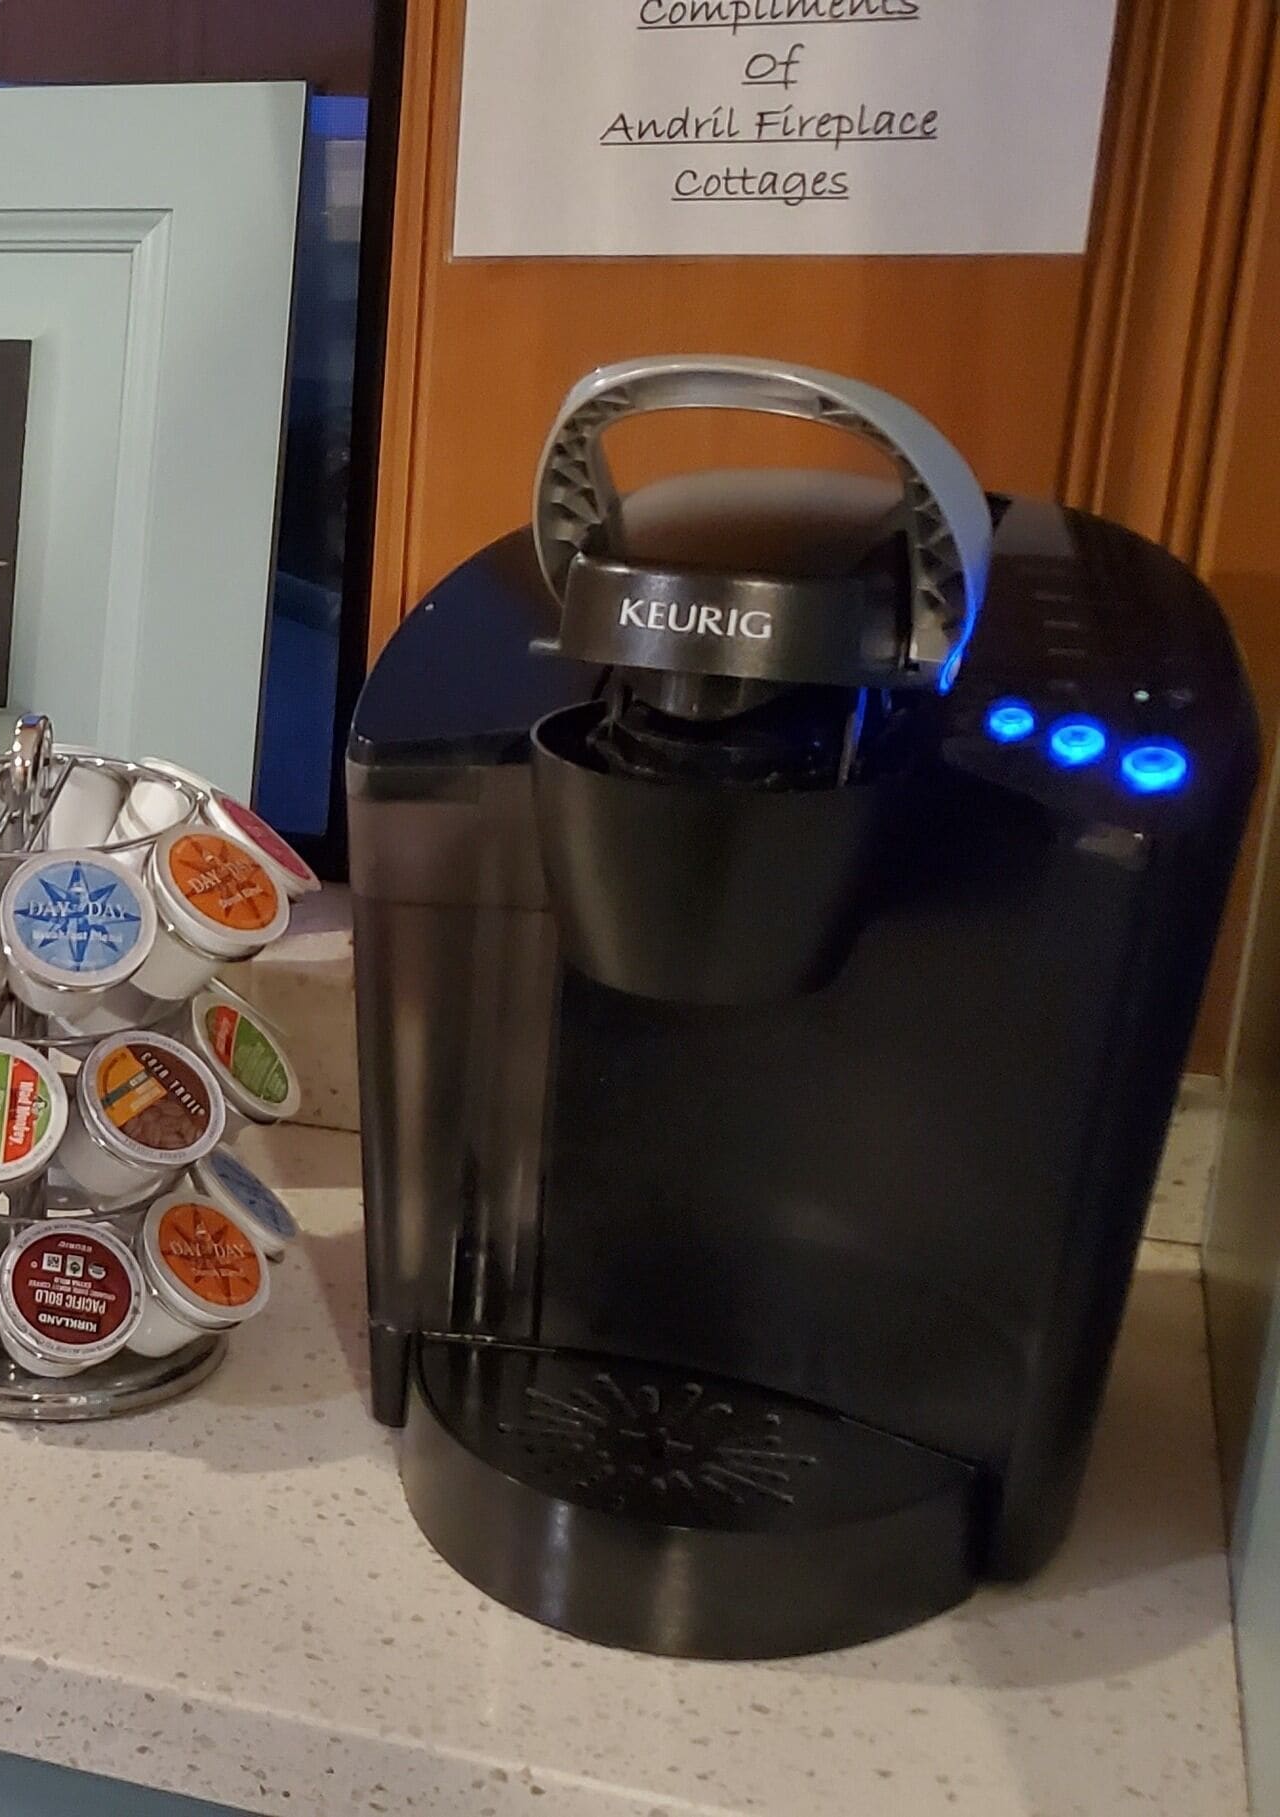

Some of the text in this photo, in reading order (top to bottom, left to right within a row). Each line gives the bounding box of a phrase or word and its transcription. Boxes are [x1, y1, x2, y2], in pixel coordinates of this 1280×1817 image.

[638, 0, 919, 35] Compliments
[744, 44, 805, 89] Of
[600, 103, 939, 150] Andril Fireplace
[673, 167, 850, 206] Cottages
[617, 596, 774, 640] KEURIG
[28, 900, 127, 919] DAY DAY
[35, 1288, 107, 1315] PACIFIC BOLD
[38, 1312, 98, 1333] KIRKLAND
